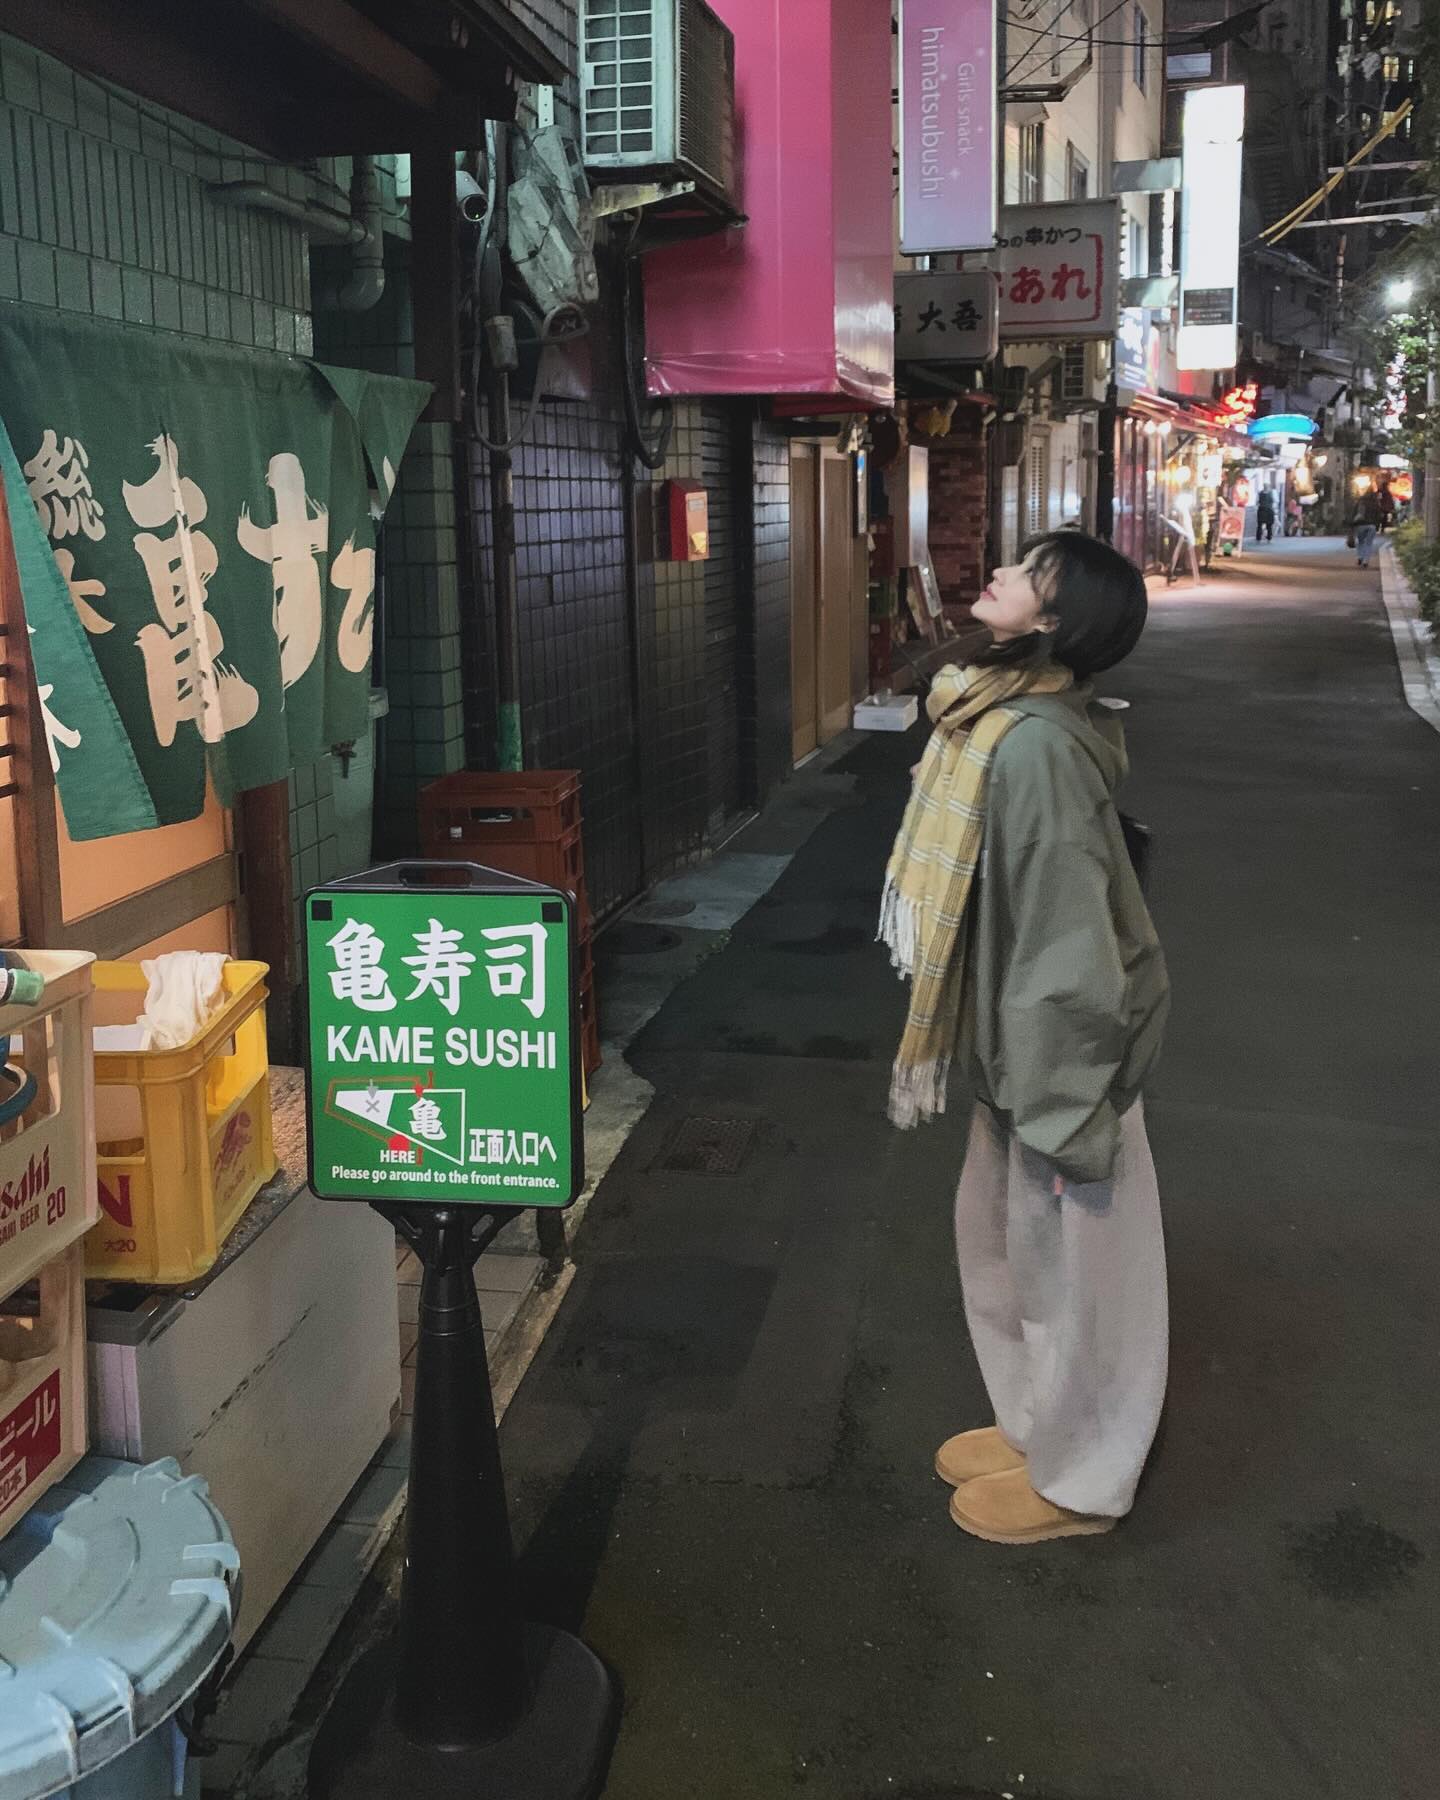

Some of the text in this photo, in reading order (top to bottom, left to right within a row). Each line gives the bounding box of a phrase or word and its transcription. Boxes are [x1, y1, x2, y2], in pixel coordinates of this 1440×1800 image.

[916, 27, 945, 199] himatsubushi
[957, 62, 977, 157] Girls snack
[996, 263, 1092, 304] あれ
[895, 299, 983, 333] 大吾
[325, 917, 549, 1019] 亀寿司
[327, 1025, 556, 1069] KAME SUSHI
[408, 1098, 447, 1140] 亀
[379, 1149, 416, 1164] HERE
[469, 1128, 558, 1166] 正面入口へ
[0, 1144, 50, 1220] sahi
[331, 1165, 560, 1189] Please go around to the front entrance.
[20, 1204, 40, 1232] BEER
[47, 1186, 66, 1226] 20
[0, 1465, 23, 1504] 0本
